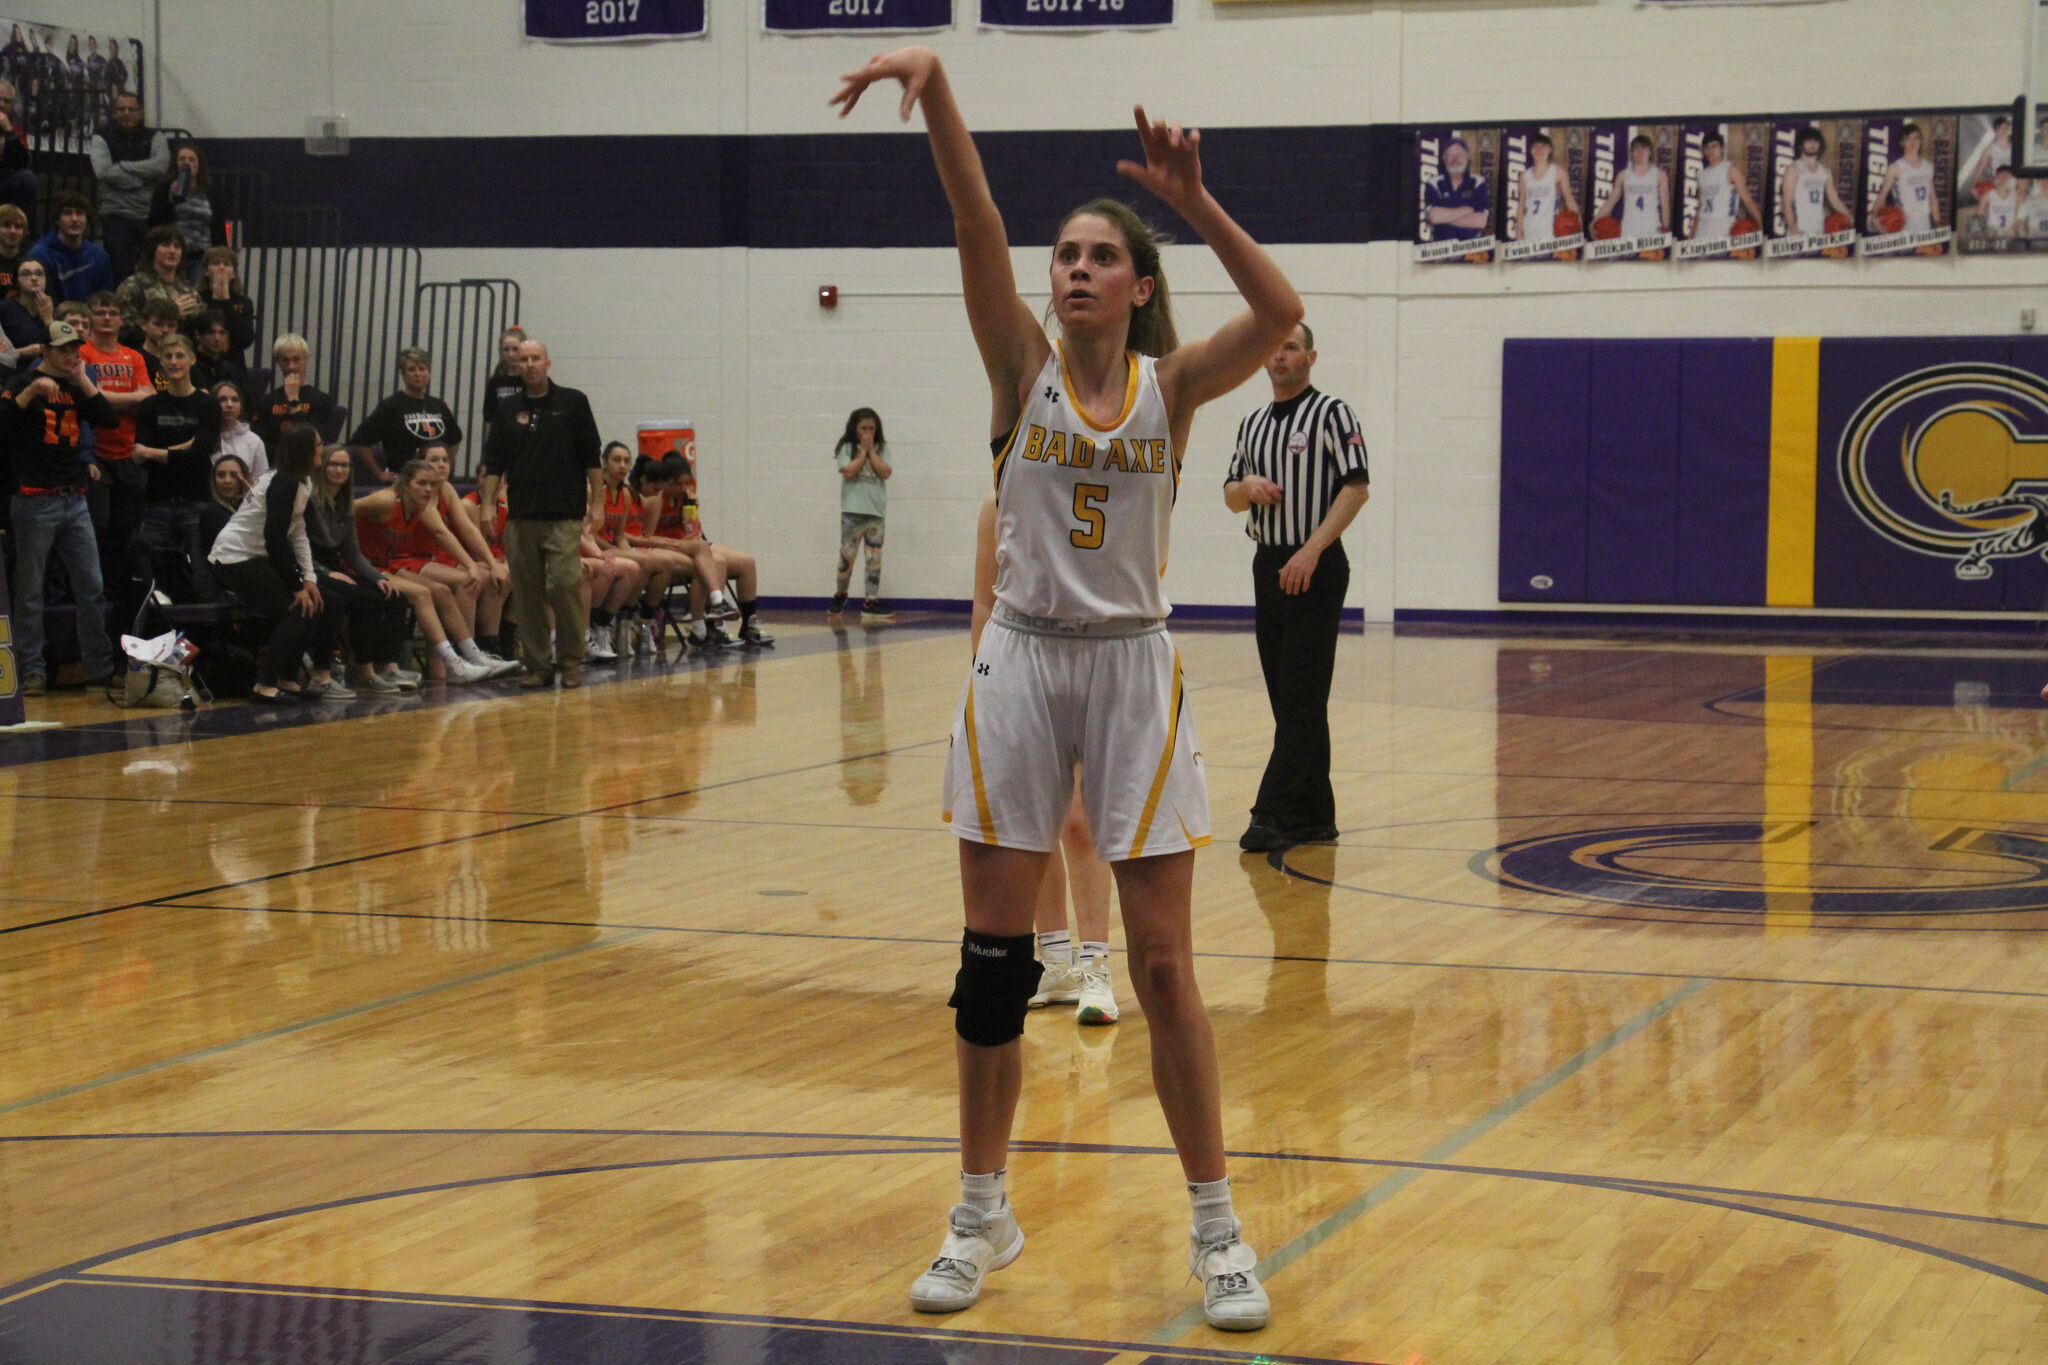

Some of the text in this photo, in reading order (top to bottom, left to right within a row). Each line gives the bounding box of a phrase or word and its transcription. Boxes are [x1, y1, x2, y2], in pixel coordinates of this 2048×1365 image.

[586, 0, 638, 23] 2017
[829, 0, 885, 15] 2017
[43, 408, 80, 447] 14
[1022, 424, 1166, 474] BAD AXE
[1070, 483, 1110, 550] 5
[970, 943, 1009, 958] Mueller
